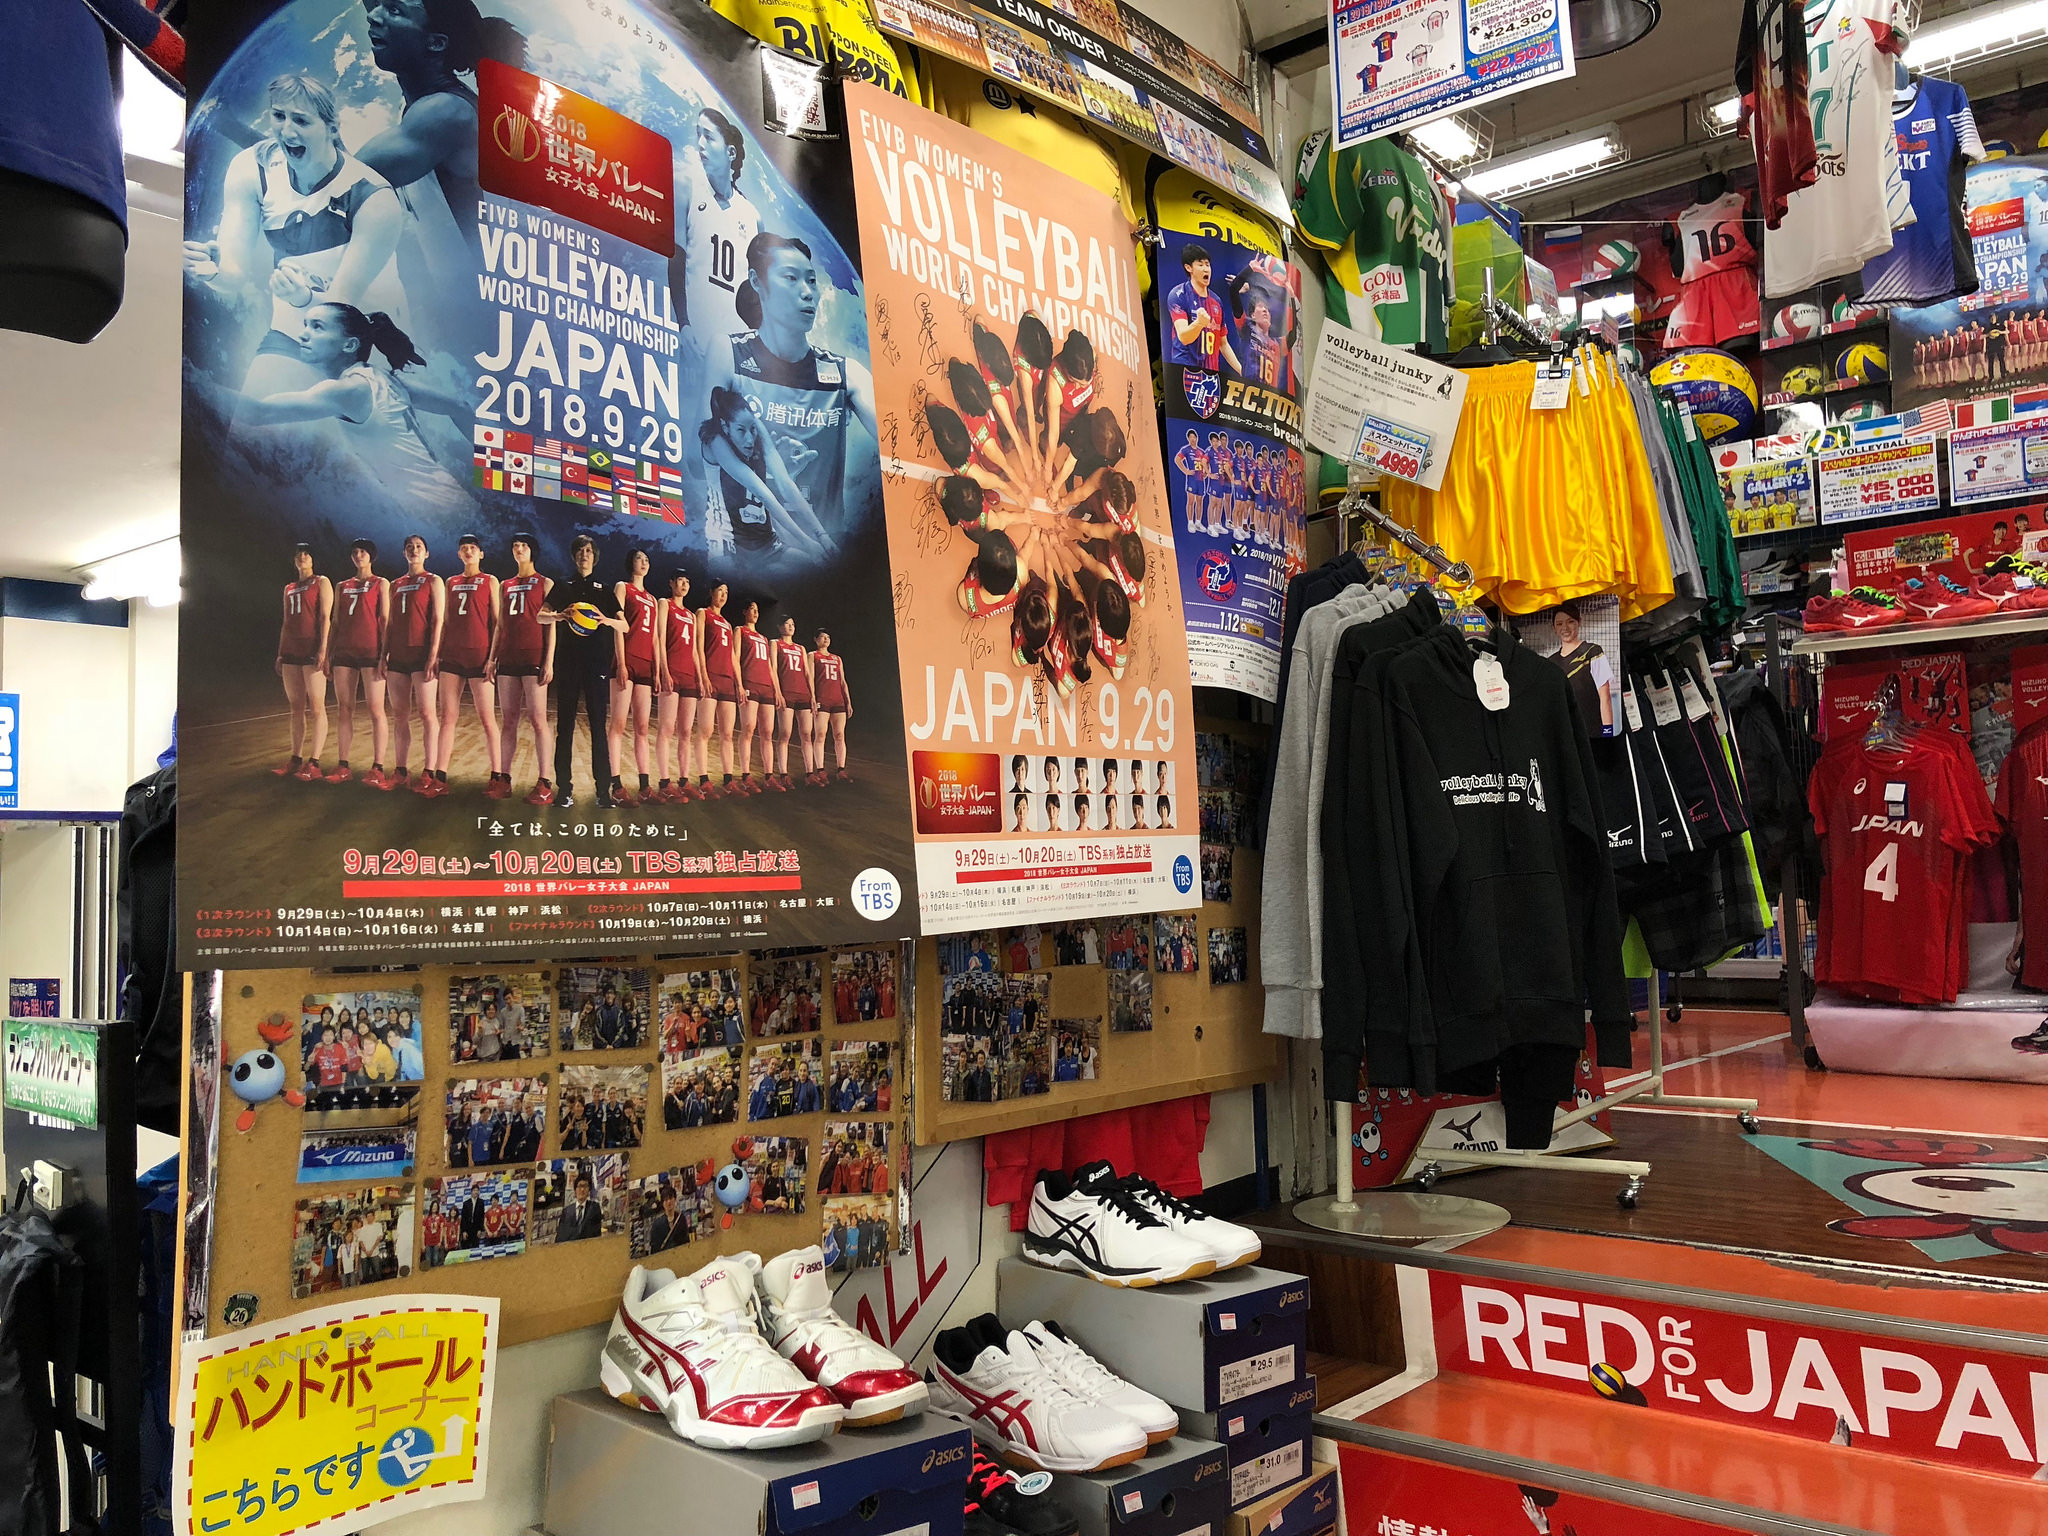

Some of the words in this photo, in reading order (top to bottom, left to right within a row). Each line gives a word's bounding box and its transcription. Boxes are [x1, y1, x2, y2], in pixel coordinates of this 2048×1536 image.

[998, 0, 1044, 30] TEAM
[1047, 16, 1109, 62] ORDER
[862, 45, 896, 75] STEEL
[860, 109, 906, 155] FIVB
[913, 134, 1004, 198] WOMEN'S
[548, 132, 665, 200] 世界バレー
[545, 166, 600, 200] 女子大会
[478, 200, 519, 229] FIVB
[527, 213, 601, 256] WOMEN'S
[864, 138, 1138, 338] VOLLEYBALL
[1692, 220, 1736, 263] 16
[1973, 234, 2027, 258] LLEYBALL
[711, 233, 735, 283] 10
[1980, 247, 2027, 264] CHAMPIONSHIP
[477, 222, 681, 333] VOLLEYBALL
[881, 223, 976, 308] WORLD
[983, 274, 1142, 375] CHAMPIONSHIP
[477, 273, 550, 316] WORLD
[555, 294, 680, 358] CHAMPIONSHIP
[1201, 330, 1215, 355] 18
[1669, 327, 1681, 339] 16
[473, 310, 680, 420] JAPAN
[1259, 355, 1274, 385] 16
[1326, 333, 1390, 368] volleyball
[1390, 360, 1434, 385] junky
[474, 374, 683, 464] 2018.9.29
[1840, 438, 1912, 456] VOLLEYBALL
[289, 593, 302, 615] 11
[348, 594, 359, 615] 7
[401, 592, 407, 614] 1
[458, 592, 467, 615] 2
[509, 592, 525, 615] 21
[642, 605, 651, 626] 3
[1220, 611, 1240, 633] 1.12
[681, 624, 690, 645] 4
[721, 627, 728, 647] 5
[754, 641, 767, 661] 10
[789, 653, 802, 672] 12
[825, 663, 838, 681] 15
[1900, 657, 1923, 669] RED
[909, 665, 1077, 748] JAPAN
[1099, 682, 1176, 752] 9.29
[938, 769, 958, 782] 2018
[1440, 773, 1497, 792] volleyball
[938, 783, 997, 803] 世界バレー
[940, 805, 965, 816] 女子大会
[476, 816, 689, 841] 「全ては、この日のために」
[1023, 869, 1036, 878] 2018
[1080, 866, 1098, 874] JAPAN
[1175, 862, 1190, 873] From
[1863, 842, 1899, 902] 4
[504, 882, 532, 893] 2018
[535, 880, 628, 894] 世界バレー女子大会
[632, 881, 671, 892] JAPAN
[859, 879, 892, 891] From
[1176, 873, 1191, 886] TBS
[440, 906, 464, 918] 横浜
[474, 905, 497, 917] 札幌
[507, 905, 529, 917] 神戸
[539, 904, 562, 916] 浜松
[778, 897, 808, 910] 名古屋
[815, 896, 835, 908] 大阪
[861, 893, 894, 911] TBS
[451, 922, 485, 934] 名古屋
[743, 914, 763, 926] 横浜
[805, 1260, 824, 1274] asics
[700, 1267, 727, 1290] asics
[1287, 1290, 1304, 1302] asics
[231, 1309, 247, 1322] 26
[226, 1340, 329, 1385] HAND
[343, 1322, 442, 1350] BALL
[1460, 1284, 1656, 1390] RED
[1658, 1315, 1700, 1403] FOR
[1257, 1357, 1273, 1371] 29.5
[201, 1336, 474, 1443] ハンドボール
[1296, 1390, 1313, 1403] asics
[355, 1387, 470, 1432] コーナー
[934, 1446, 966, 1467] asics
[1266, 1454, 1281, 1469] 31.0
[1203, 1460, 1223, 1477] asics
[201, 1440, 376, 1534] こちらです
